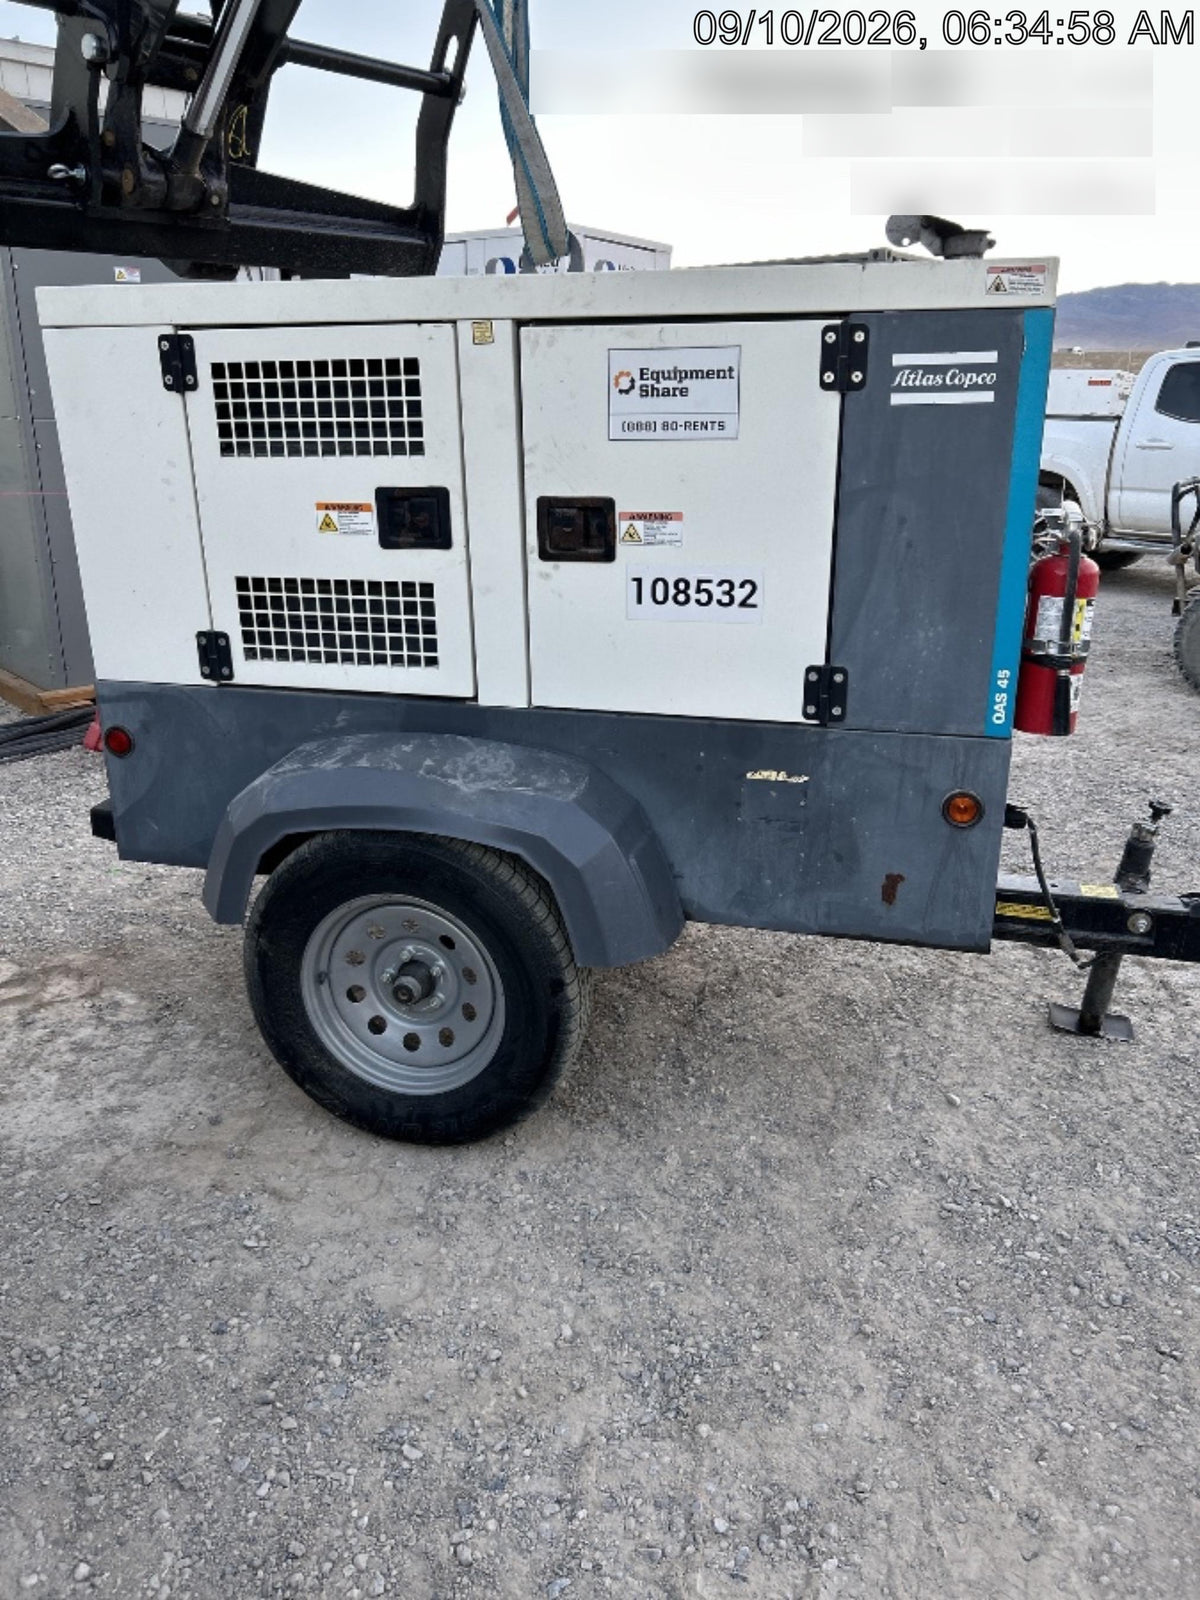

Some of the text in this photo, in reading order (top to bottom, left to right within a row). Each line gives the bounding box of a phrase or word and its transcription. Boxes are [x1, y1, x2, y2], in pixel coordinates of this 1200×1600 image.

[638, 365, 735, 385] Equipment
[890, 368, 997, 388] Atlas Copco
[638, 383, 689, 398] Share
[661, 420, 726, 432] 80-RENTS
[631, 577, 758, 608] 108532
[997, 669, 1011, 689] 45
